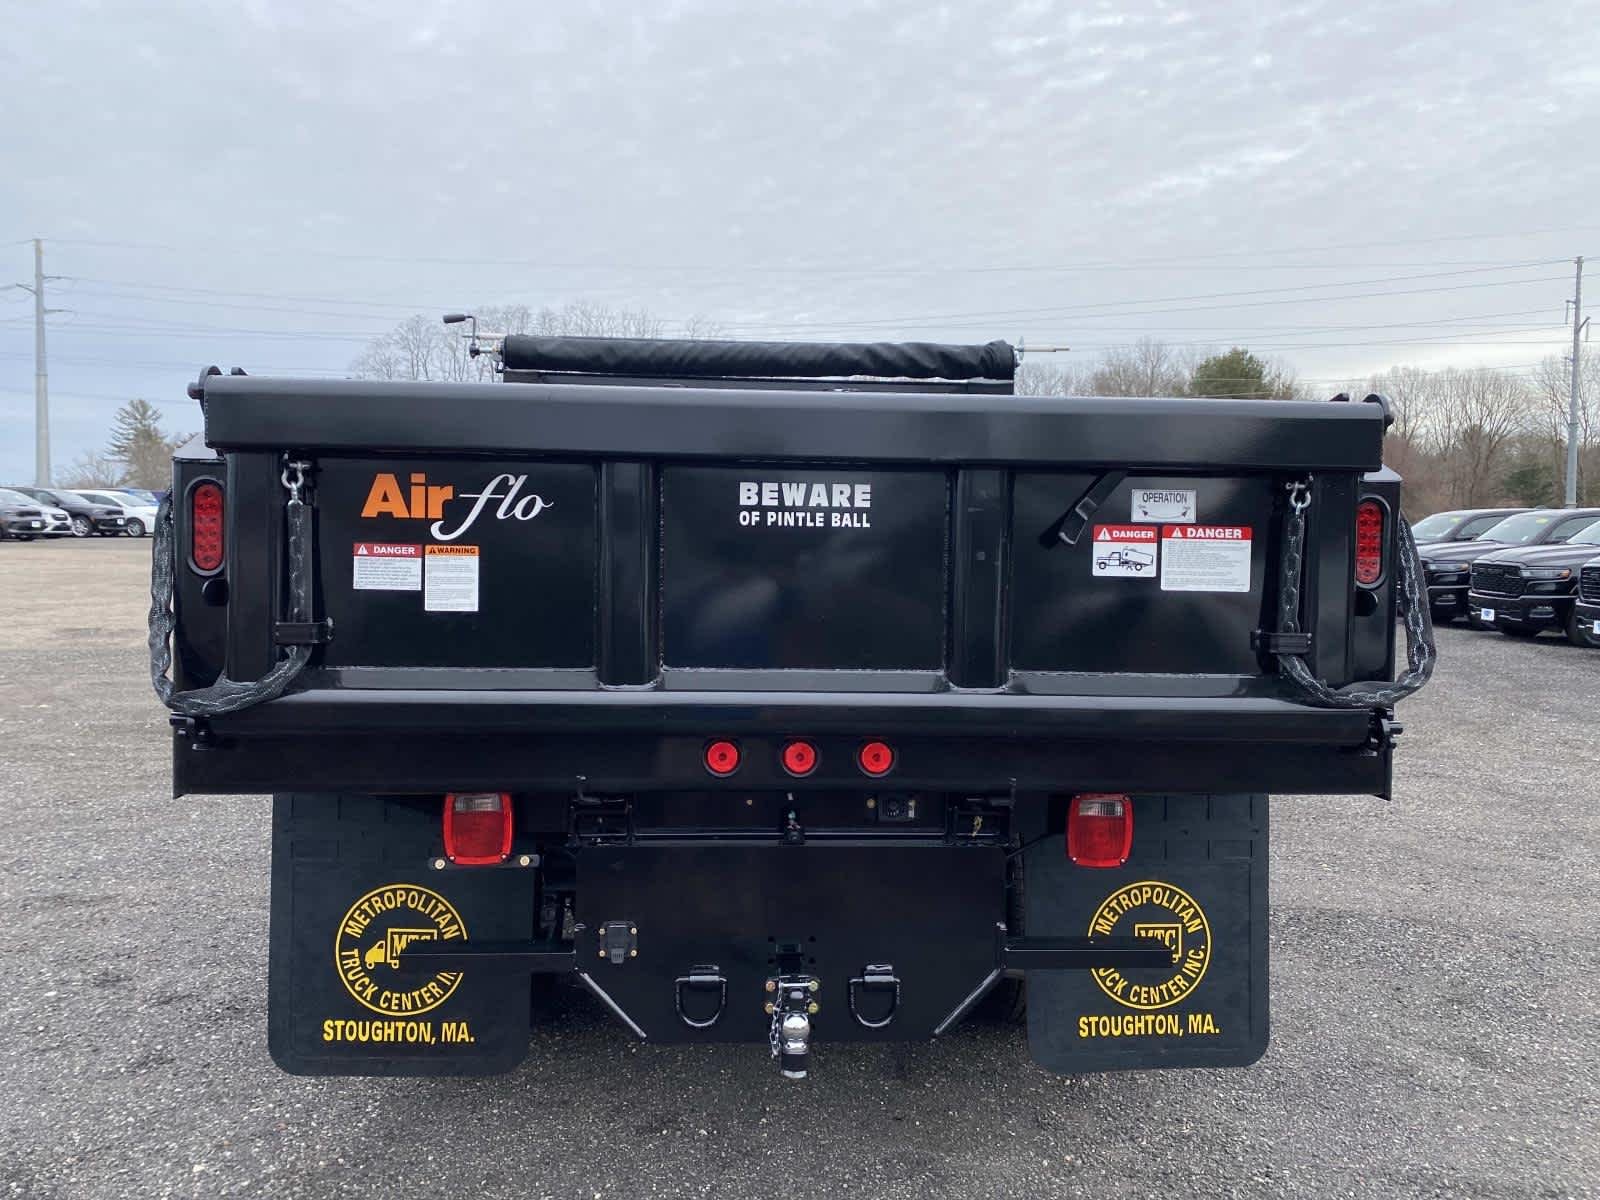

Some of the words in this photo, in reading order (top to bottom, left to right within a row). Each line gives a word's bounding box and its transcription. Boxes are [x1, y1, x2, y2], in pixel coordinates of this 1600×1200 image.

[739, 482, 871, 508] BEWARE
[1142, 492, 1188, 504] OPERATION
[739, 511, 760, 526] OF
[767, 511, 825, 527] PINTLE
[831, 512, 871, 528] BALL
[1112, 530, 1154, 539] DANGER
[1186, 527, 1242, 539] DANGER
[373, 545, 415, 555] DANGER
[437, 546, 476, 555] WARNING
[344, 890, 460, 940] METROPOLITAN
[1094, 886, 1204, 936] METROPOLITAN
[341, 948, 379, 1001] TRUCK
[379, 982, 444, 1011] CENTER
[1129, 974, 1190, 1004] CENTER
[323, 1020, 436, 1045] STOUGHTON,
[441, 1022, 475, 1043] MA.
[1078, 1014, 1184, 1038] STOUGHTON,
[1188, 1013, 1220, 1034] MA.
